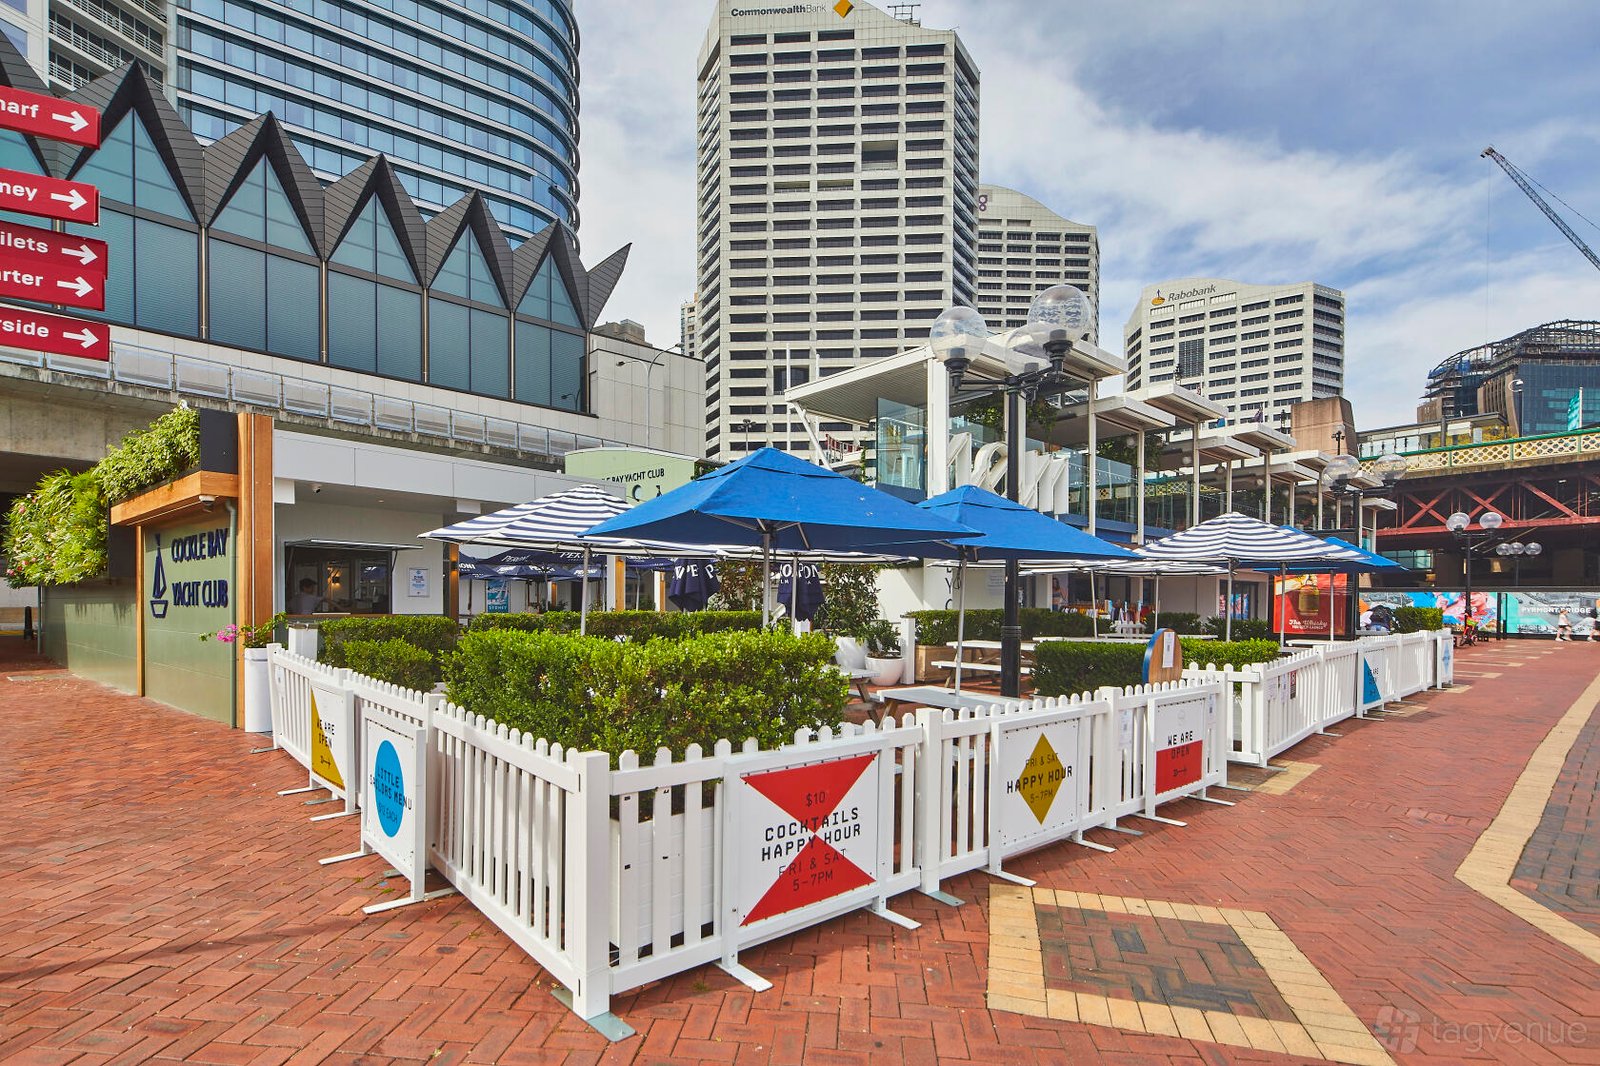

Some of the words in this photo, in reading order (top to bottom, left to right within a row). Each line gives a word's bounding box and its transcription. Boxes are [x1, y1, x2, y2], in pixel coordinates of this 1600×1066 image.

[731, 4, 827, 17] CommonwealthBank
[1168, 284, 1216, 301] Rabobank
[623, 471, 646, 483] YACHT
[647, 468, 665, 479] CLUB
[171, 532, 207, 563] COCKLE
[207, 527, 230, 559] BAY
[172, 581, 201, 607] YACHT
[202, 579, 229, 608] CLUB
[1168, 734, 1178, 747] WE
[1180, 731, 1193, 743] ARE
[1171, 747, 1190, 760] OPEN
[377, 765, 400, 789] LITTLE
[1006, 772, 1044, 794] HAPPY
[1047, 765, 1073, 784] HOUR
[393, 790, 413, 811] MENU
[806, 791, 826, 807] $10
[765, 807, 859, 842] COCKTAILS
[761, 836, 816, 862] HAPPY
[824, 823, 861, 845] HOUR
[778, 861, 802, 878] FRI
[809, 857, 817, 869] &
[824, 848, 846, 865] SAT
